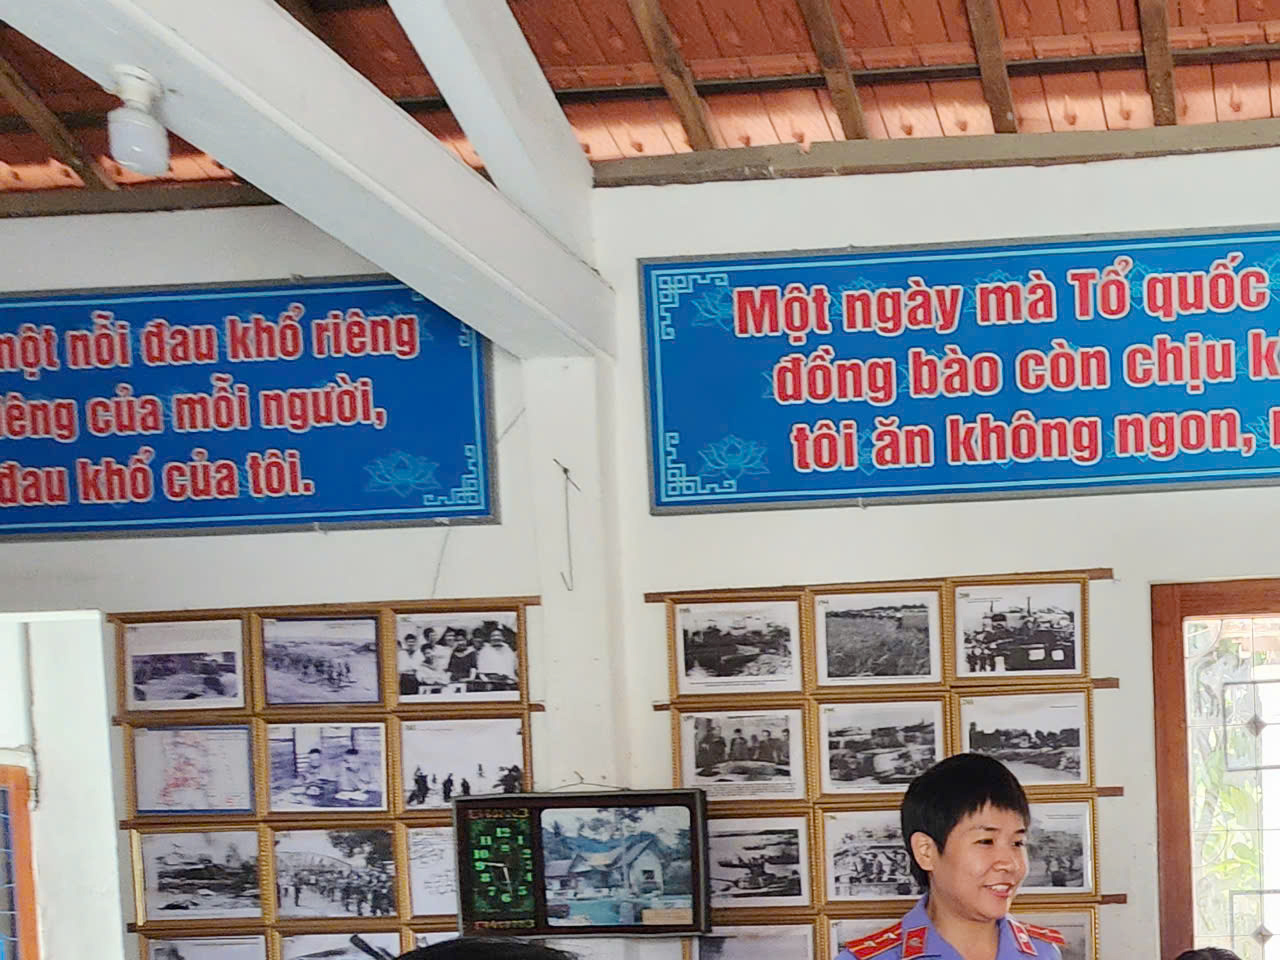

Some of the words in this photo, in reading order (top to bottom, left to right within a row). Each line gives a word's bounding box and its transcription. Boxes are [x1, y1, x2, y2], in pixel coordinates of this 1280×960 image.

[733, 284, 831, 345] Một
[843, 278, 962, 336] ngày
[976, 271, 1056, 325] mà
[1068, 255, 1132, 319] Tổ
[1144, 253, 1269, 321] quốc
[68, 311, 131, 368] nỗi
[141, 320, 218, 365] đau
[227, 303, 304, 361] khổ
[313, 308, 419, 359] riêng
[773, 345, 896, 405] đồng
[909, 345, 1001, 397] bào
[1017, 340, 1109, 392] còn
[1125, 334, 1235, 393] chịu
[0, 392, 78, 442] êng
[87, 384, 163, 435] của
[173, 373, 250, 431] mỗi
[261, 373, 387, 432] người,
[790, 420, 857, 471] tôi
[873, 417, 933, 467] ăn
[947, 411, 1101, 464] không
[1115, 410, 1255, 459] ngon,
[0, 460, 69, 507] đau
[77, 447, 153, 503] khổ
[164, 449, 239, 501] của
[247, 450, 315, 497] tôi.
